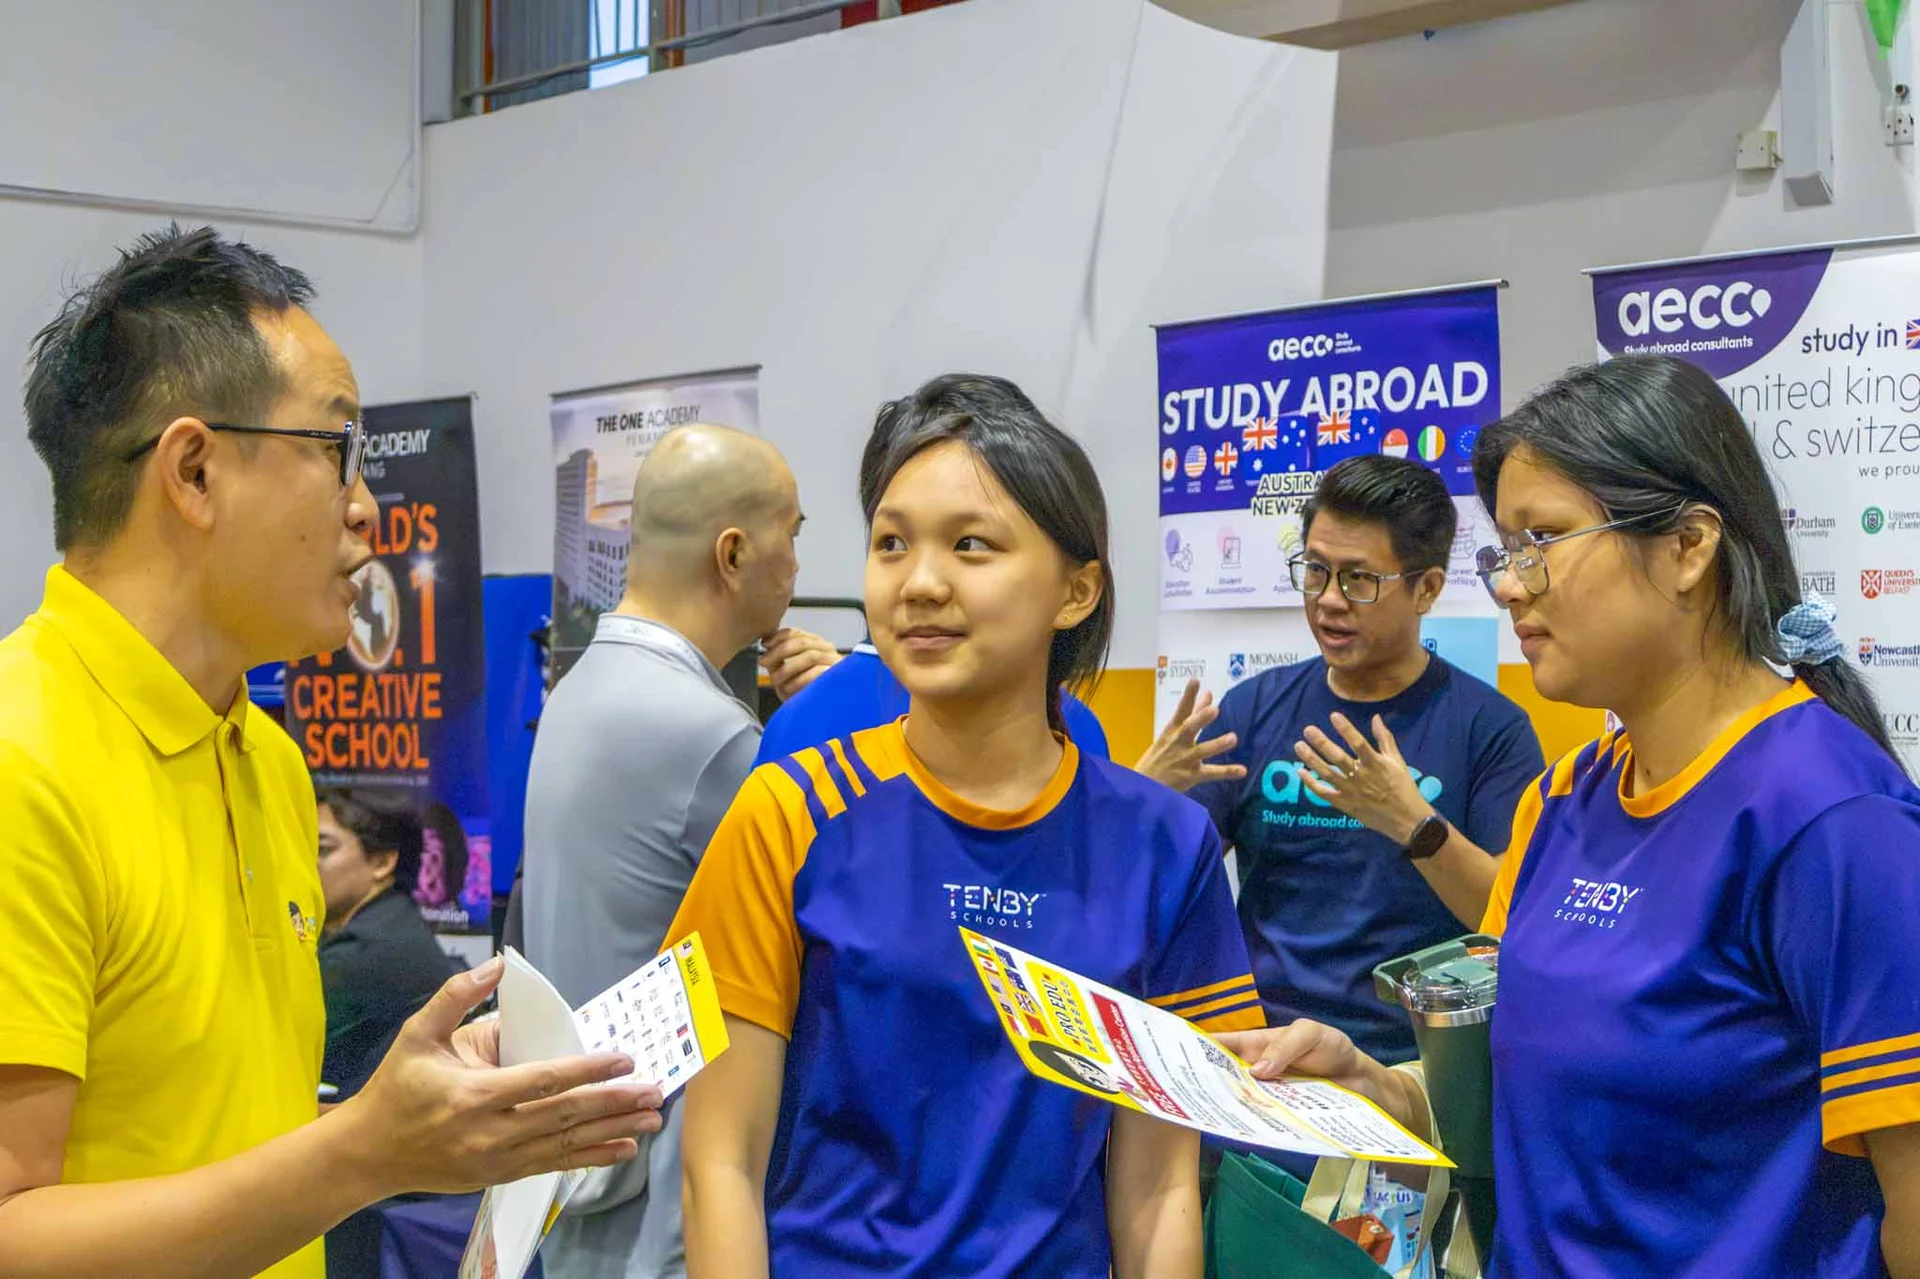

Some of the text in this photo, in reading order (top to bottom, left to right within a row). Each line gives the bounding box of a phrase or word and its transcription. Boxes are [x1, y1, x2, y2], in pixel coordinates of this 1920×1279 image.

[1618, 282, 1771, 337] aecc
[1268, 334, 1334, 362] aecc
[1650, 340, 1690, 354] abroad
[1691, 335, 1754, 352] consultants
[1802, 322, 1898, 355] study in
[1162, 360, 1489, 435] STUDY ABROAD
[596, 405, 701, 434] THE ONE ACADEMY
[1772, 419, 1797, 460] &
[1858, 466, 1880, 478] we
[1252, 497, 1290, 518] NEW
[372, 501, 439, 556] LD'S
[1796, 516, 1836, 530] Durham
[1887, 520, 1897, 532] of
[1802, 577, 1836, 592] BATH
[1884, 569, 1915, 578] QUEEN'S
[1249, 652, 1299, 666] MONASH
[293, 672, 442, 720] CREATIVE
[305, 722, 430, 769] SCHOOL
[1262, 809, 1296, 829] Study
[1297, 813, 1347, 829] abroad
[943, 884, 1040, 916] TENBY
[1563, 878, 1640, 914] TENBY
[951, 911, 1033, 929] SCHOOLS
[1554, 909, 1616, 929] SCHOOLS
